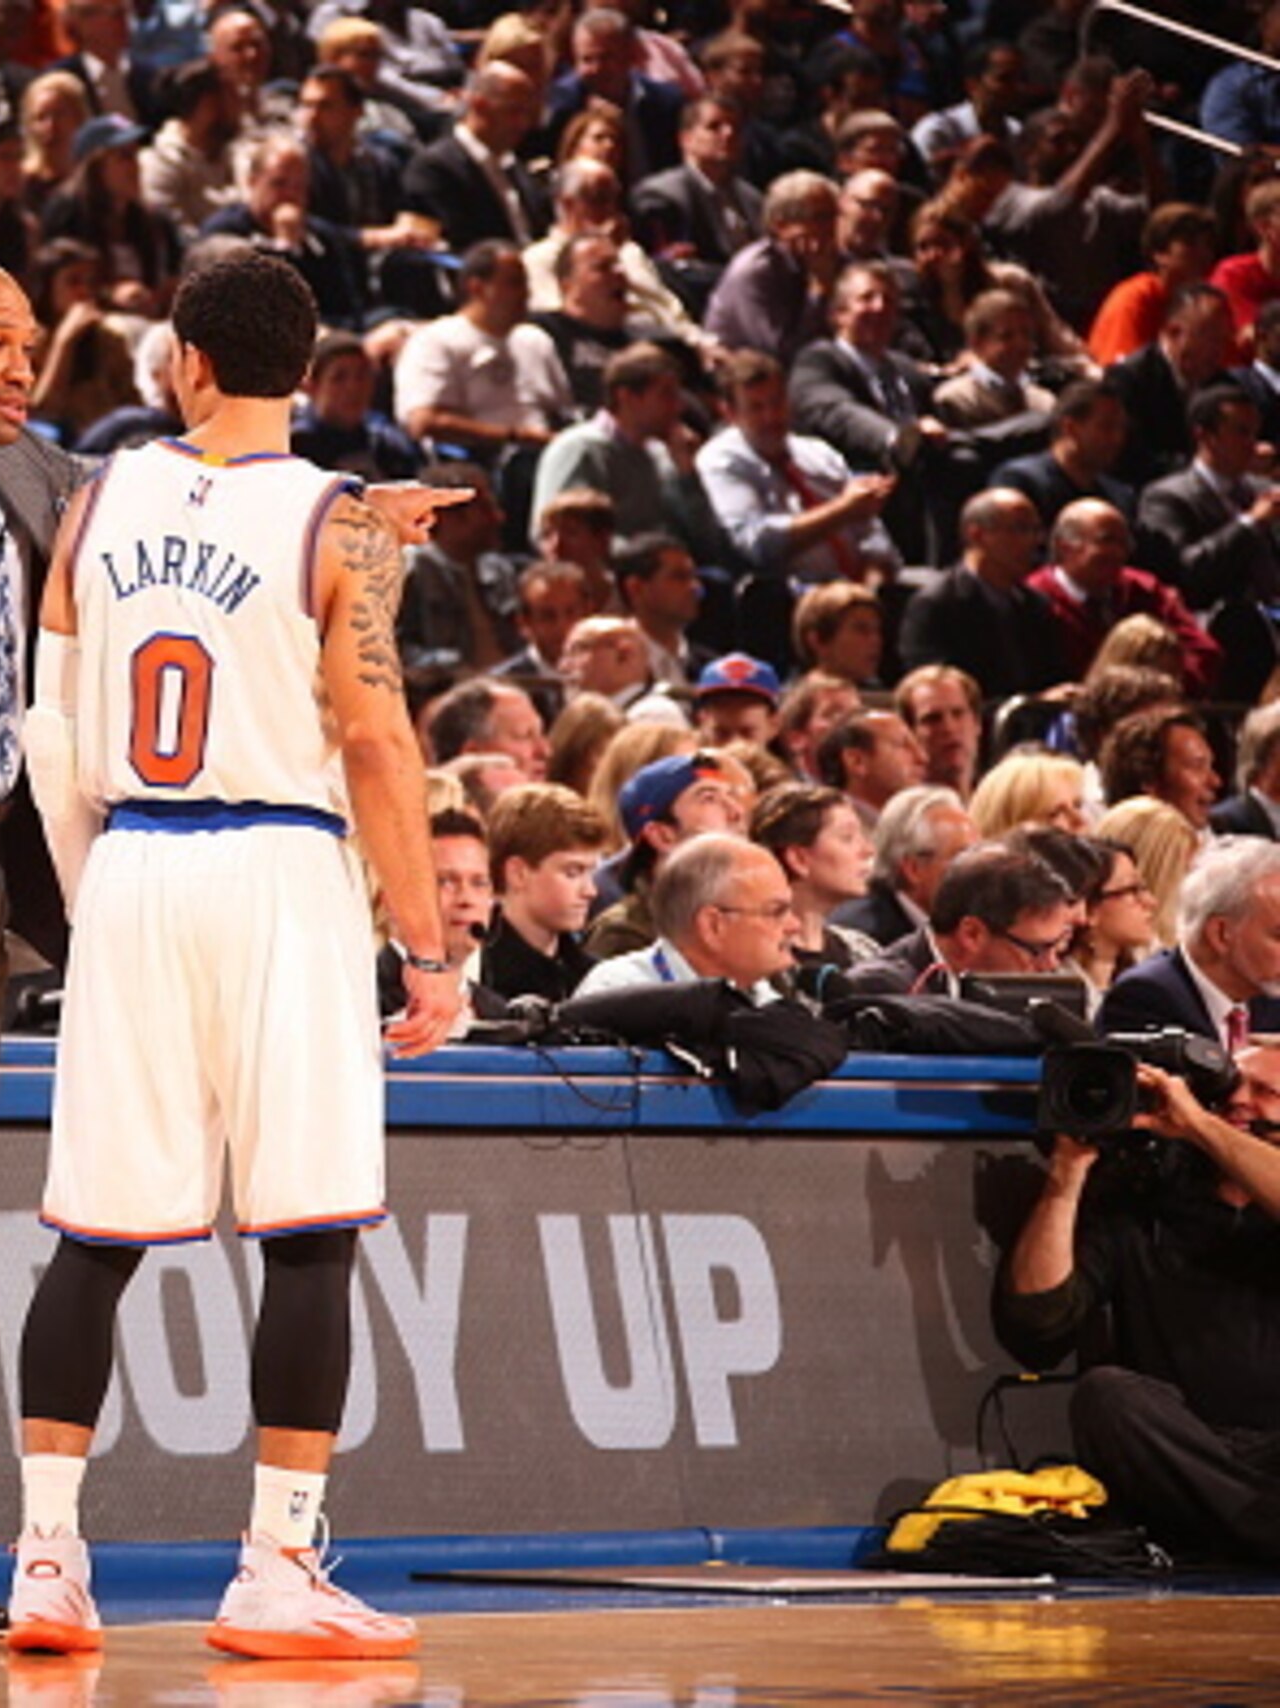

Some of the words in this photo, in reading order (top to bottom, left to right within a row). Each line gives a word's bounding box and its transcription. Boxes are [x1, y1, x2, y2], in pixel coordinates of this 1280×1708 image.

[100, 535, 260, 614] LARKIN
[128, 631, 215, 789] 0
[537, 1213, 783, 1450] UP
